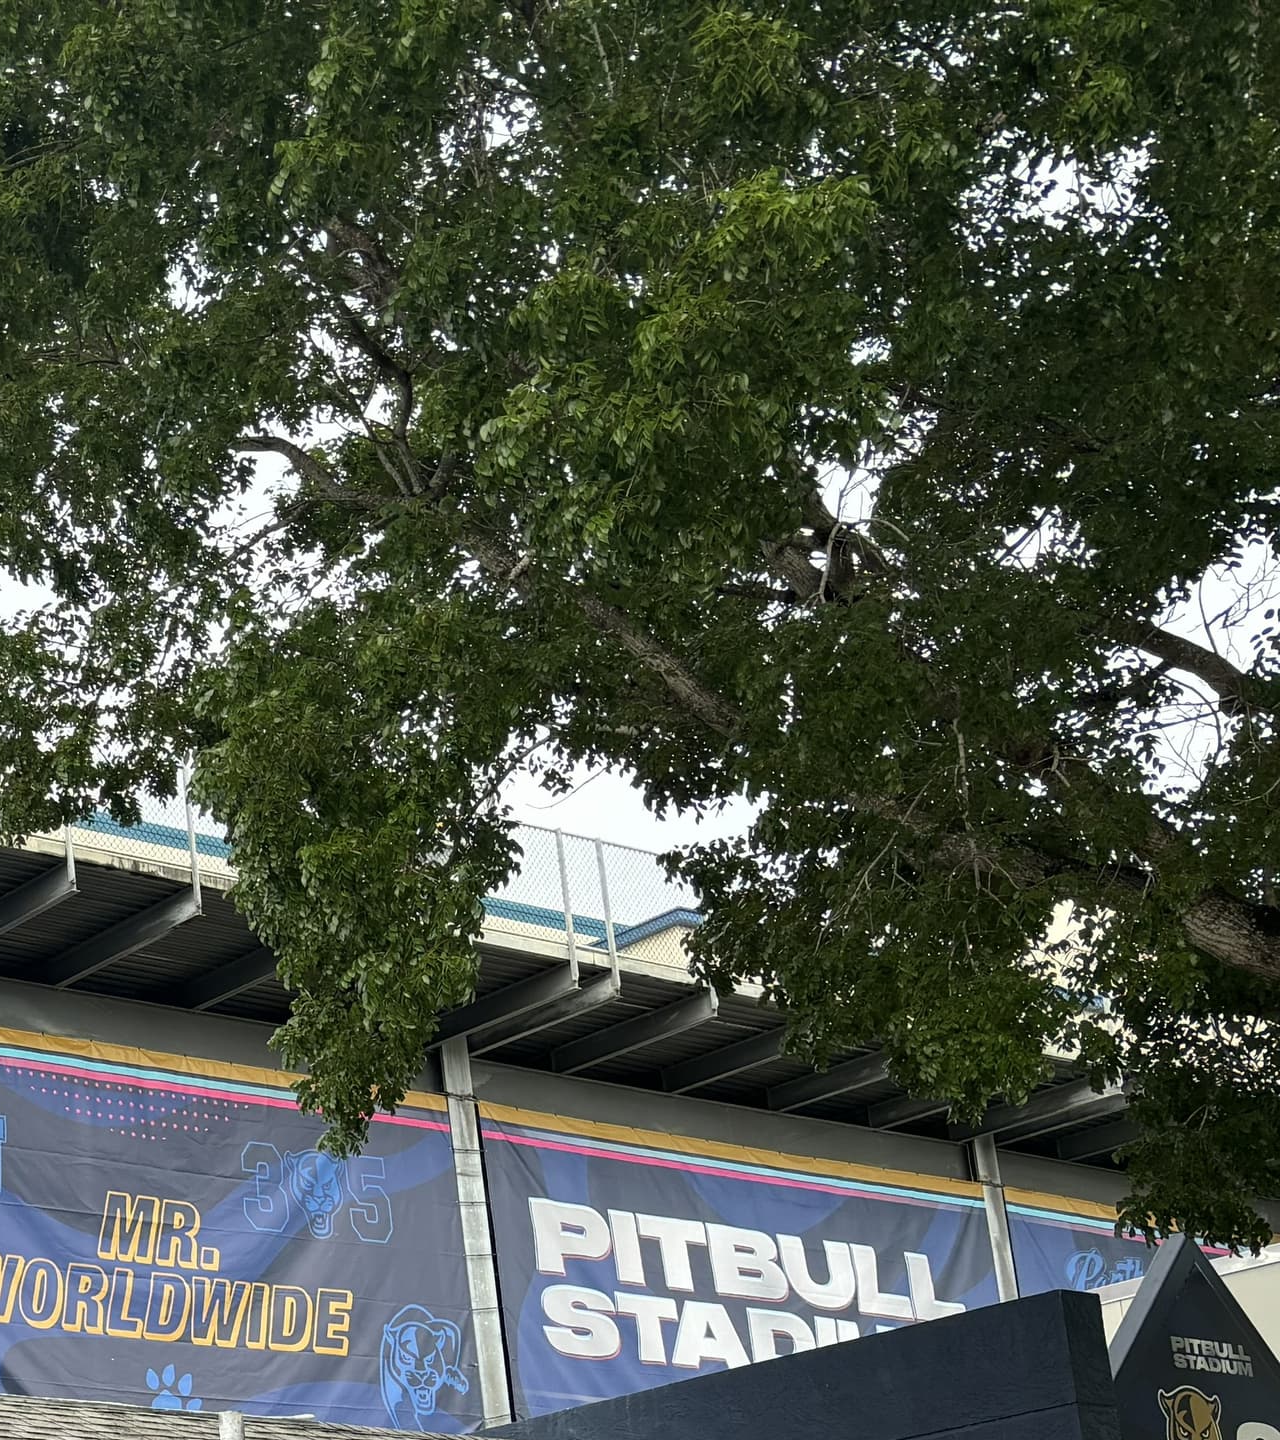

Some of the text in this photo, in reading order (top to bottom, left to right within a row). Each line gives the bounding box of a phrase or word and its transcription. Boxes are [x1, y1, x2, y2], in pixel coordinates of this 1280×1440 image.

[96, 1190, 221, 1271] MR.
[527, 1196, 967, 1322] PITBULL
[1170, 1335, 1252, 1361] PITBULL
[1172, 1353, 1254, 1378] STADIUM
